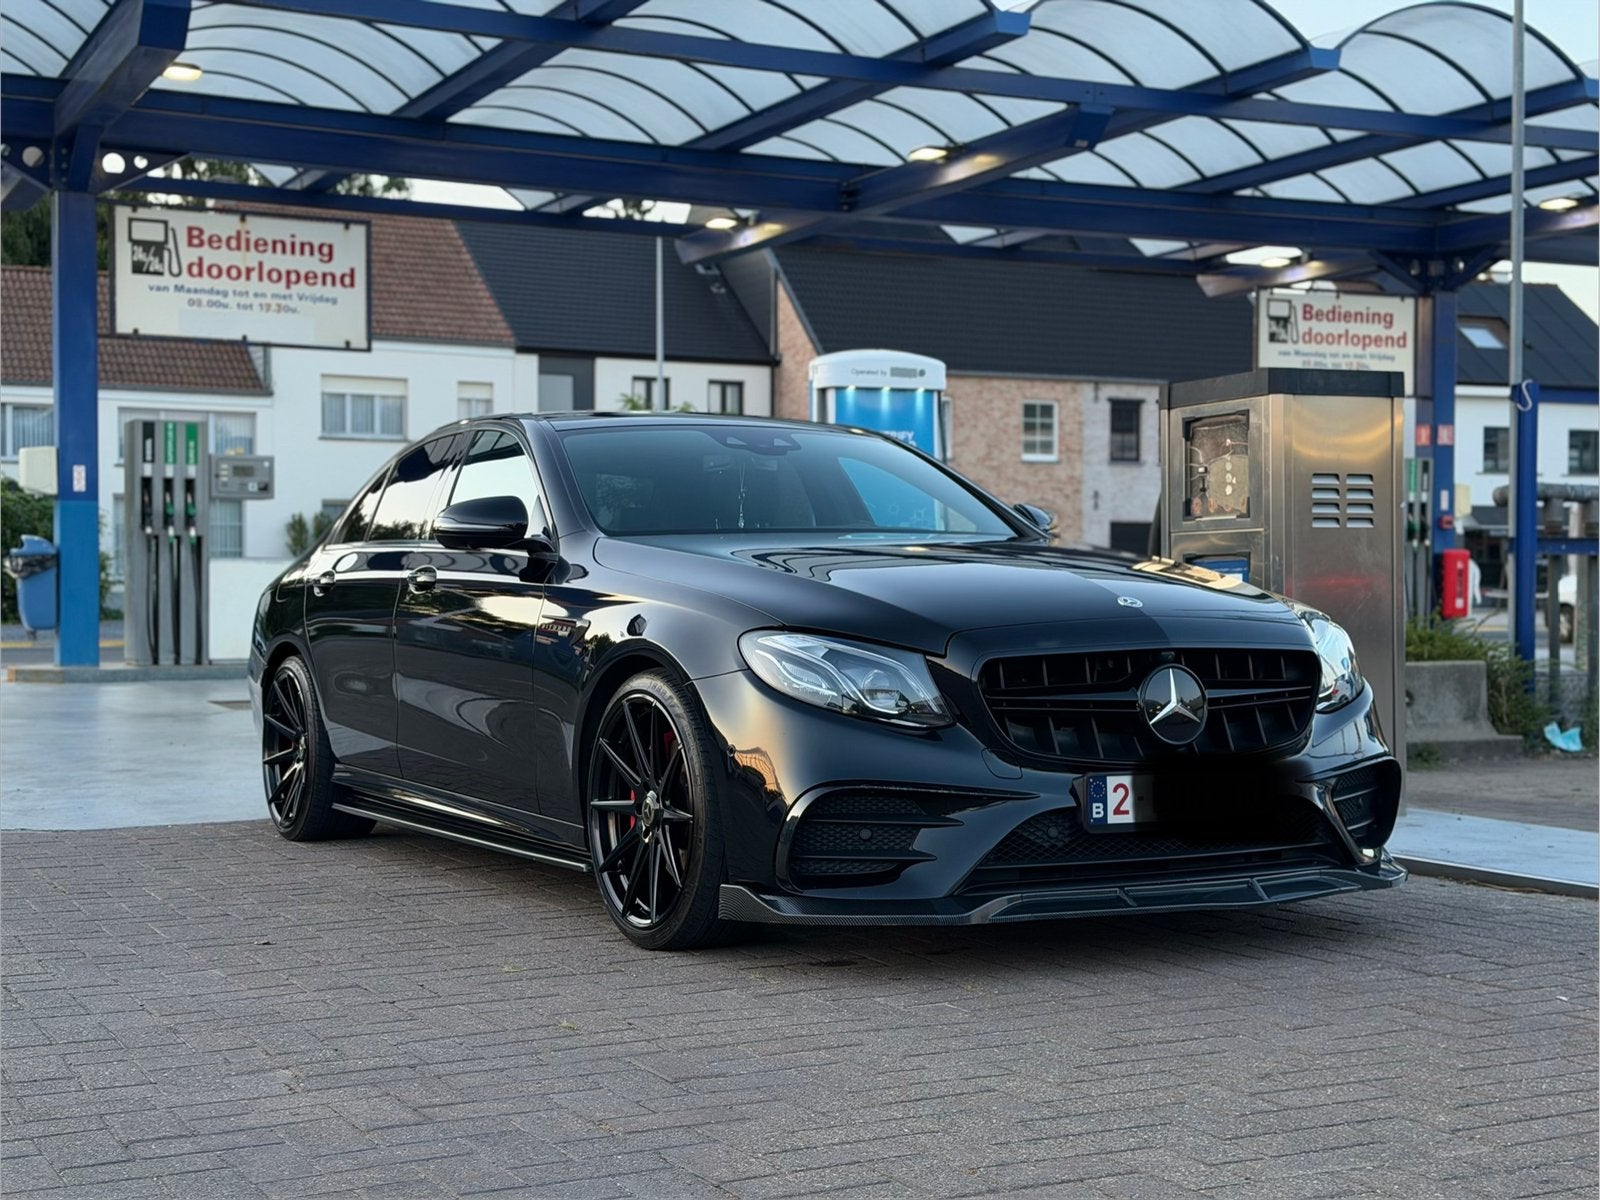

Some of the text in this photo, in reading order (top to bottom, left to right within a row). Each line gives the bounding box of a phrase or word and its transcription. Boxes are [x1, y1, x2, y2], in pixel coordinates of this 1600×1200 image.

[187, 225, 334, 263] Bediening
[187, 256, 356, 289] doorlopend
[148, 284, 338, 305] van Maandag tot en met Vrijdag
[236, 300, 254, 311] tot
[1302, 303, 1394, 329] Bediening
[1302, 327, 1408, 350] doorlopend
[1092, 802, 1104, 818] B
